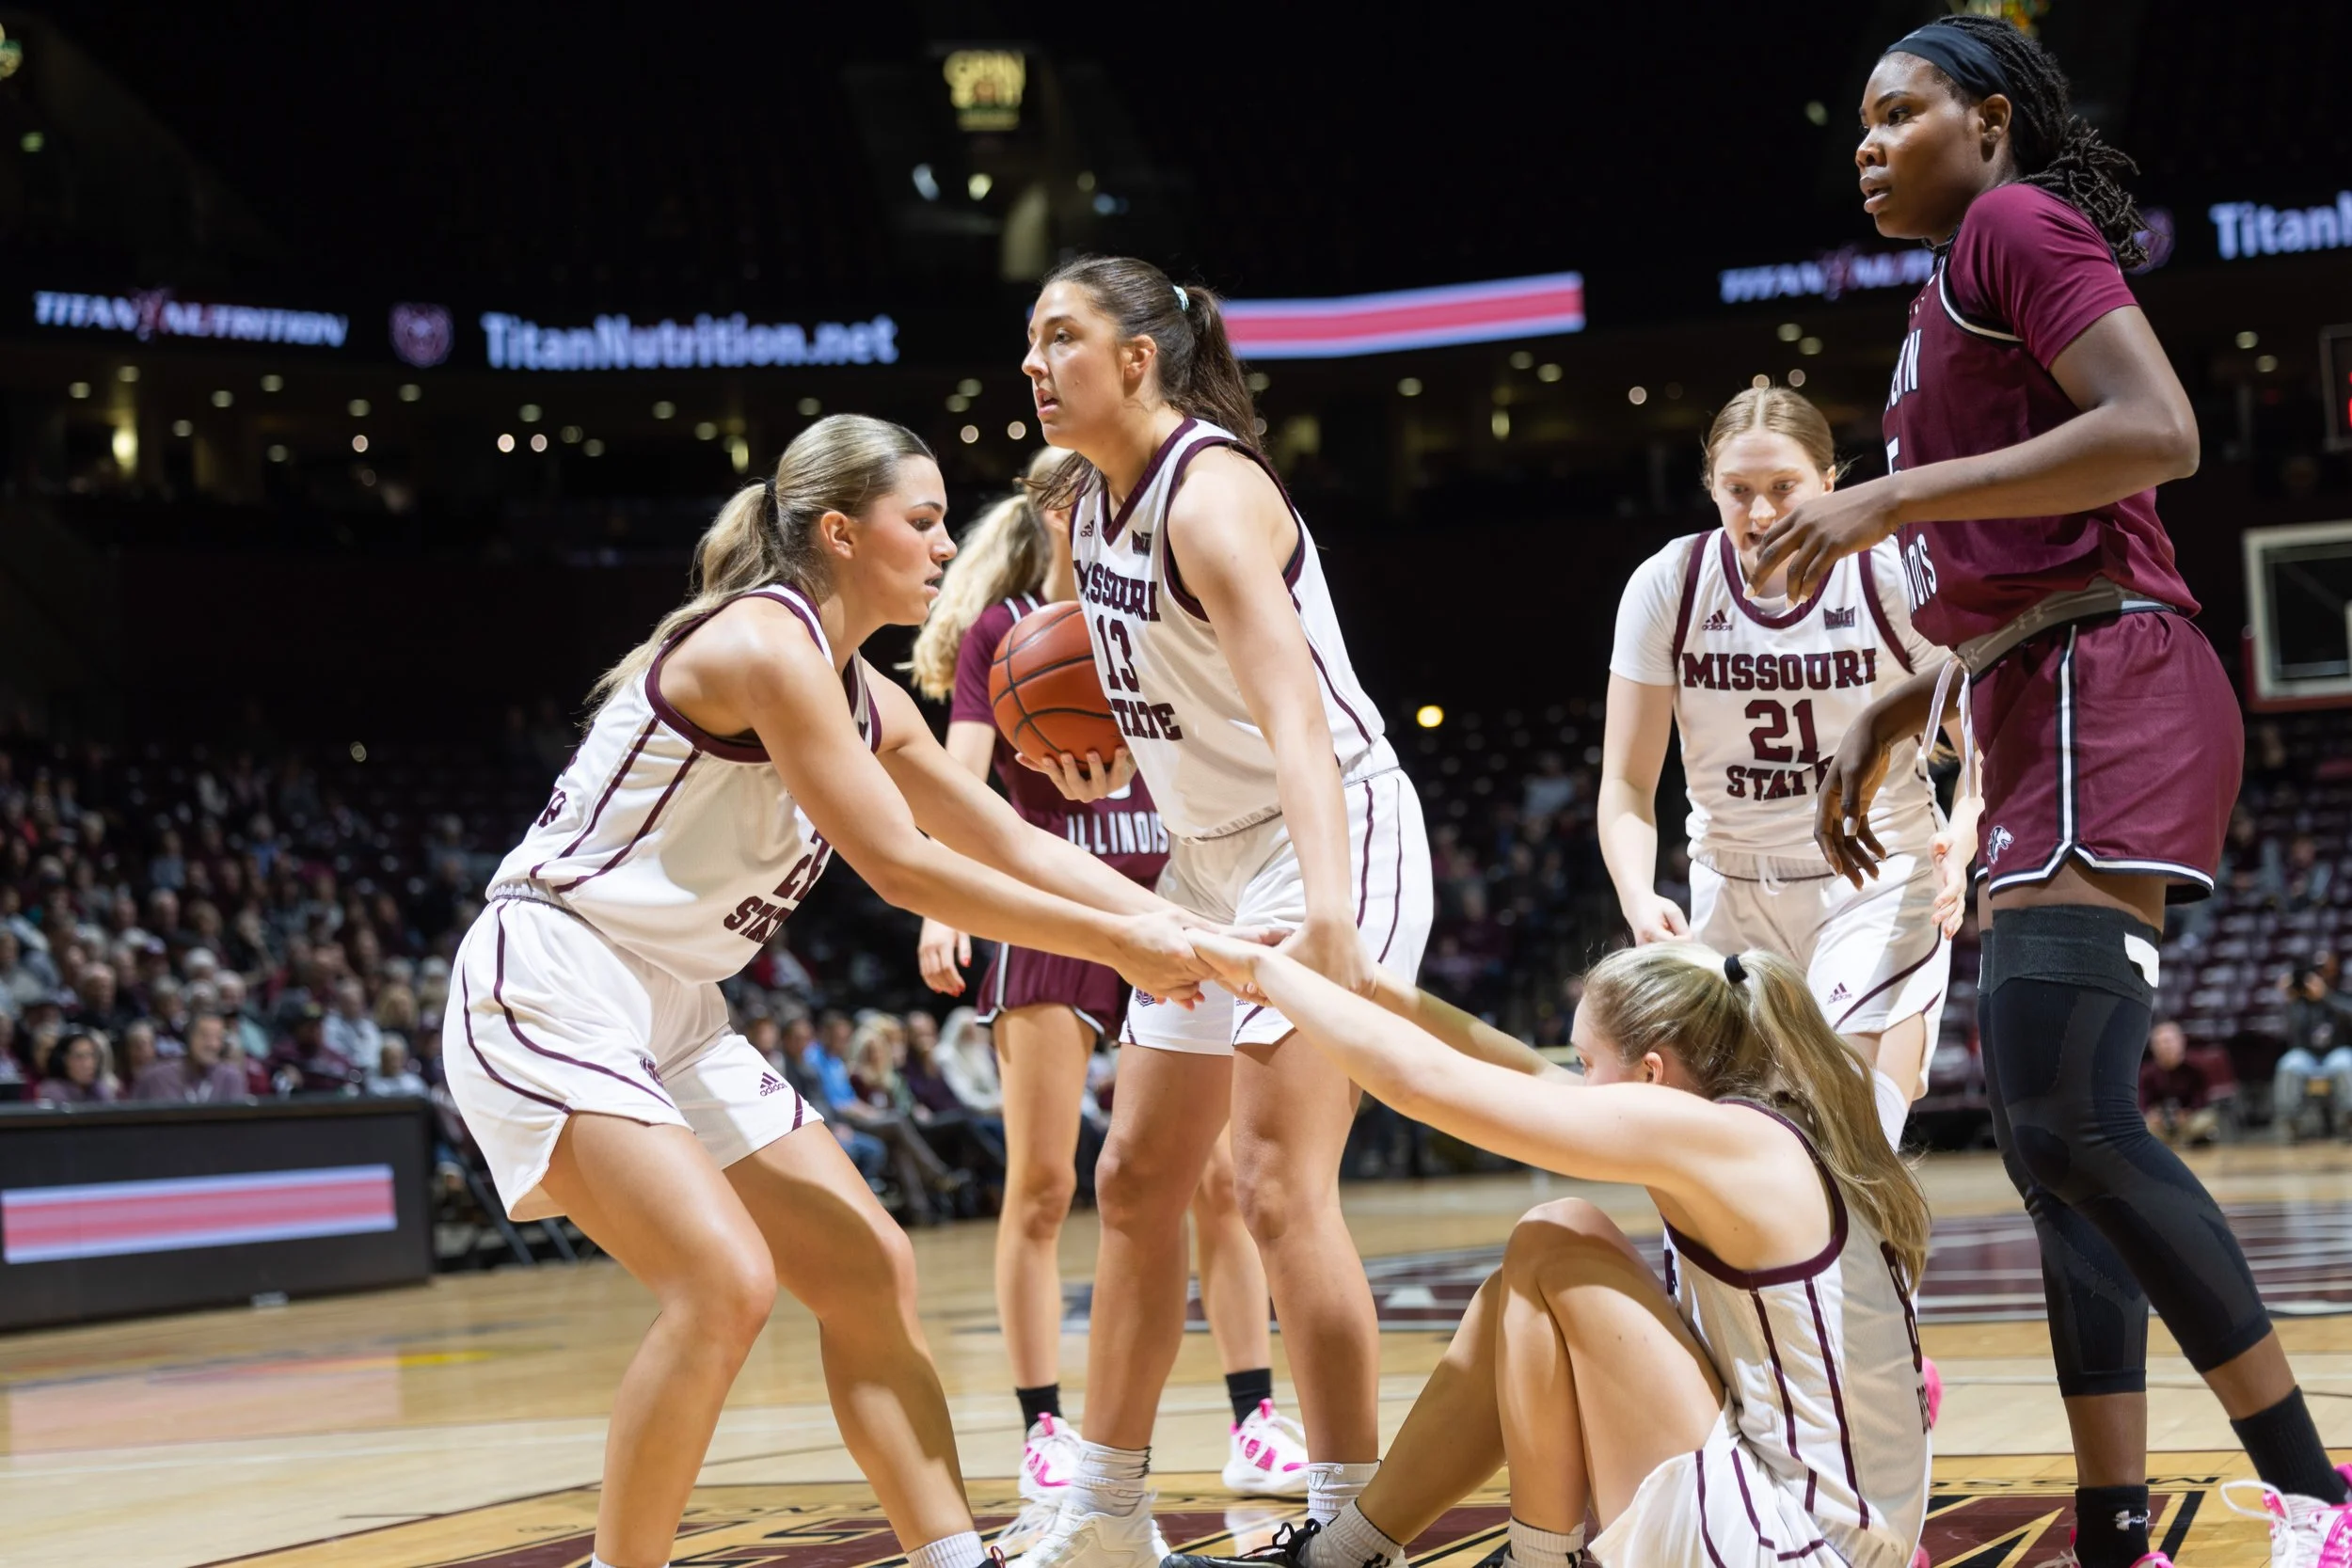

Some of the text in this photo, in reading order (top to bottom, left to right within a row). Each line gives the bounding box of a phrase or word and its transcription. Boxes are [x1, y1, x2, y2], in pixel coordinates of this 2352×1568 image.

[481, 311, 898, 370] TitanNutrition.net
[1097, 614, 1139, 693] 13
[1682, 648, 1877, 691] MISSOURI
[1107, 698, 1184, 741] TATE
[1745, 699, 1820, 764] 21
[1067, 811, 1169, 855] ILLINOIS
[723, 895, 793, 944] STAT
[760, 1082, 787, 1097] adidas
